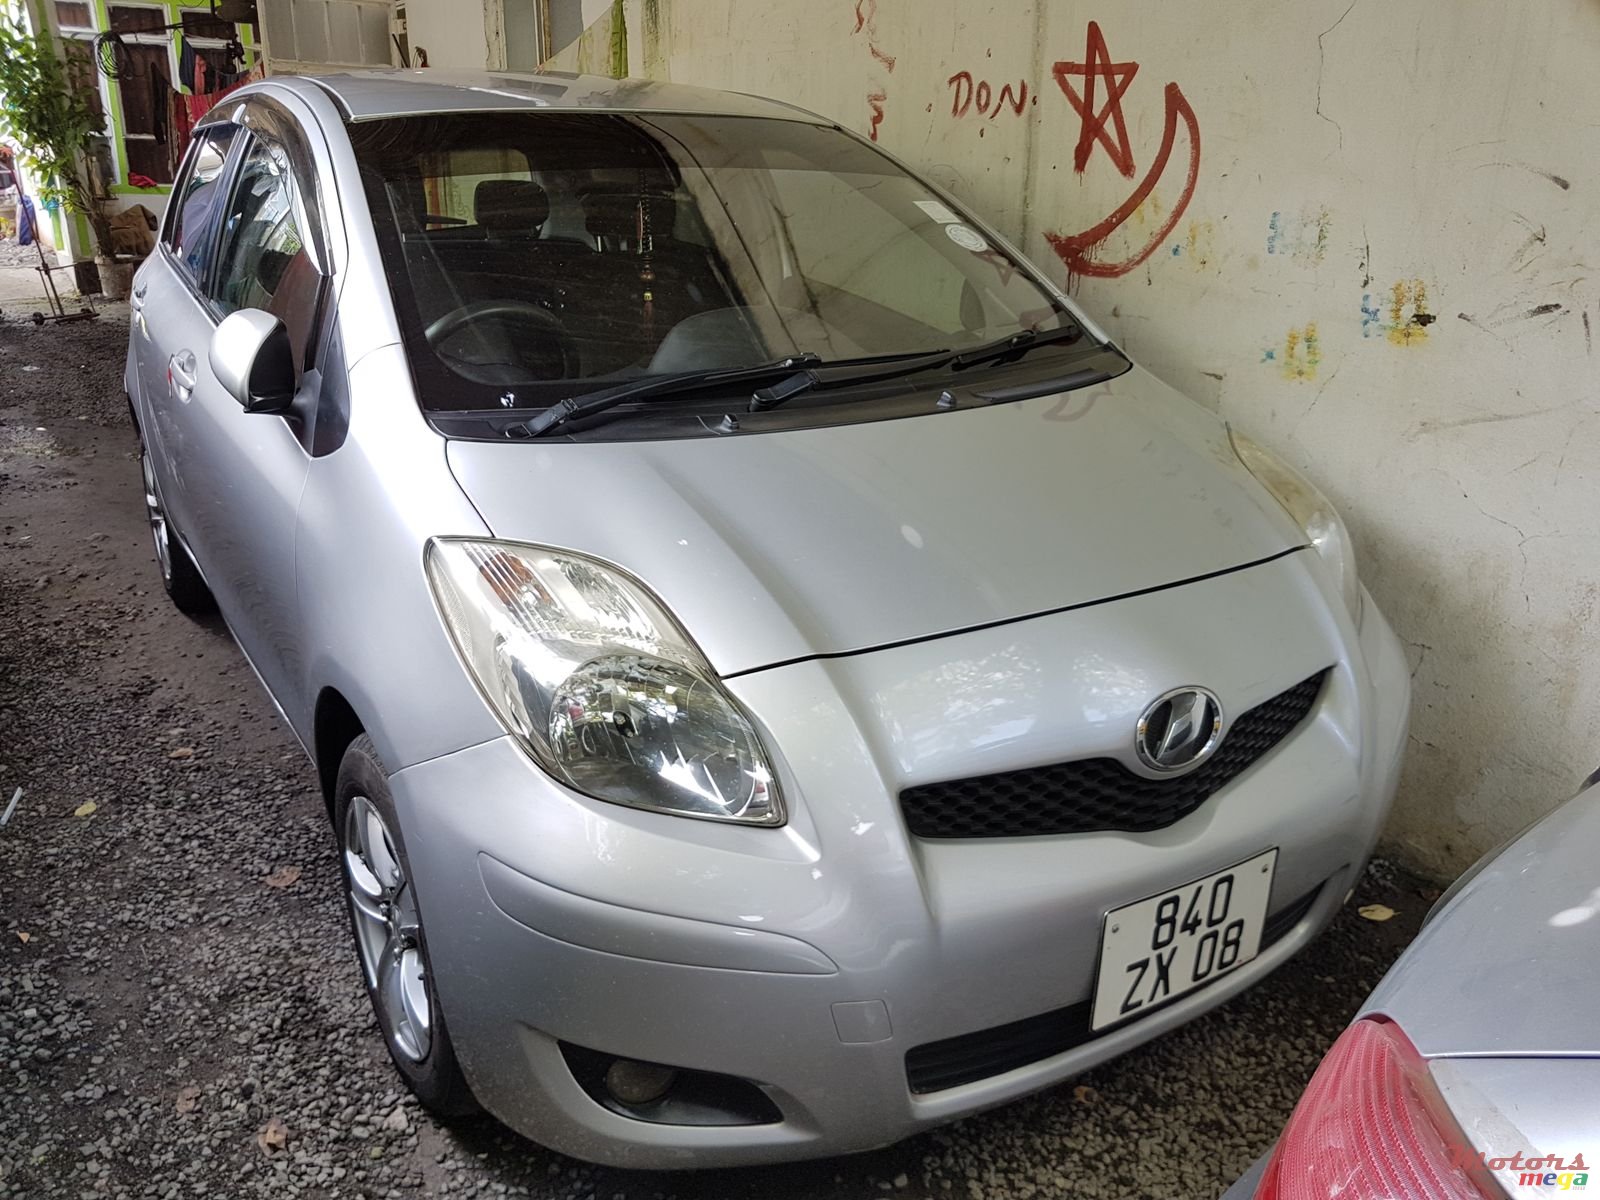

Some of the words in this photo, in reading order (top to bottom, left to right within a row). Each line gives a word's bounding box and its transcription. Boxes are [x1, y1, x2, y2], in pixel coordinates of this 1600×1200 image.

[947, 71, 1028, 119] DON
[1152, 873, 1235, 951] 840
[1119, 945, 1178, 1015] ZX
[1191, 918, 1245, 982] 08
